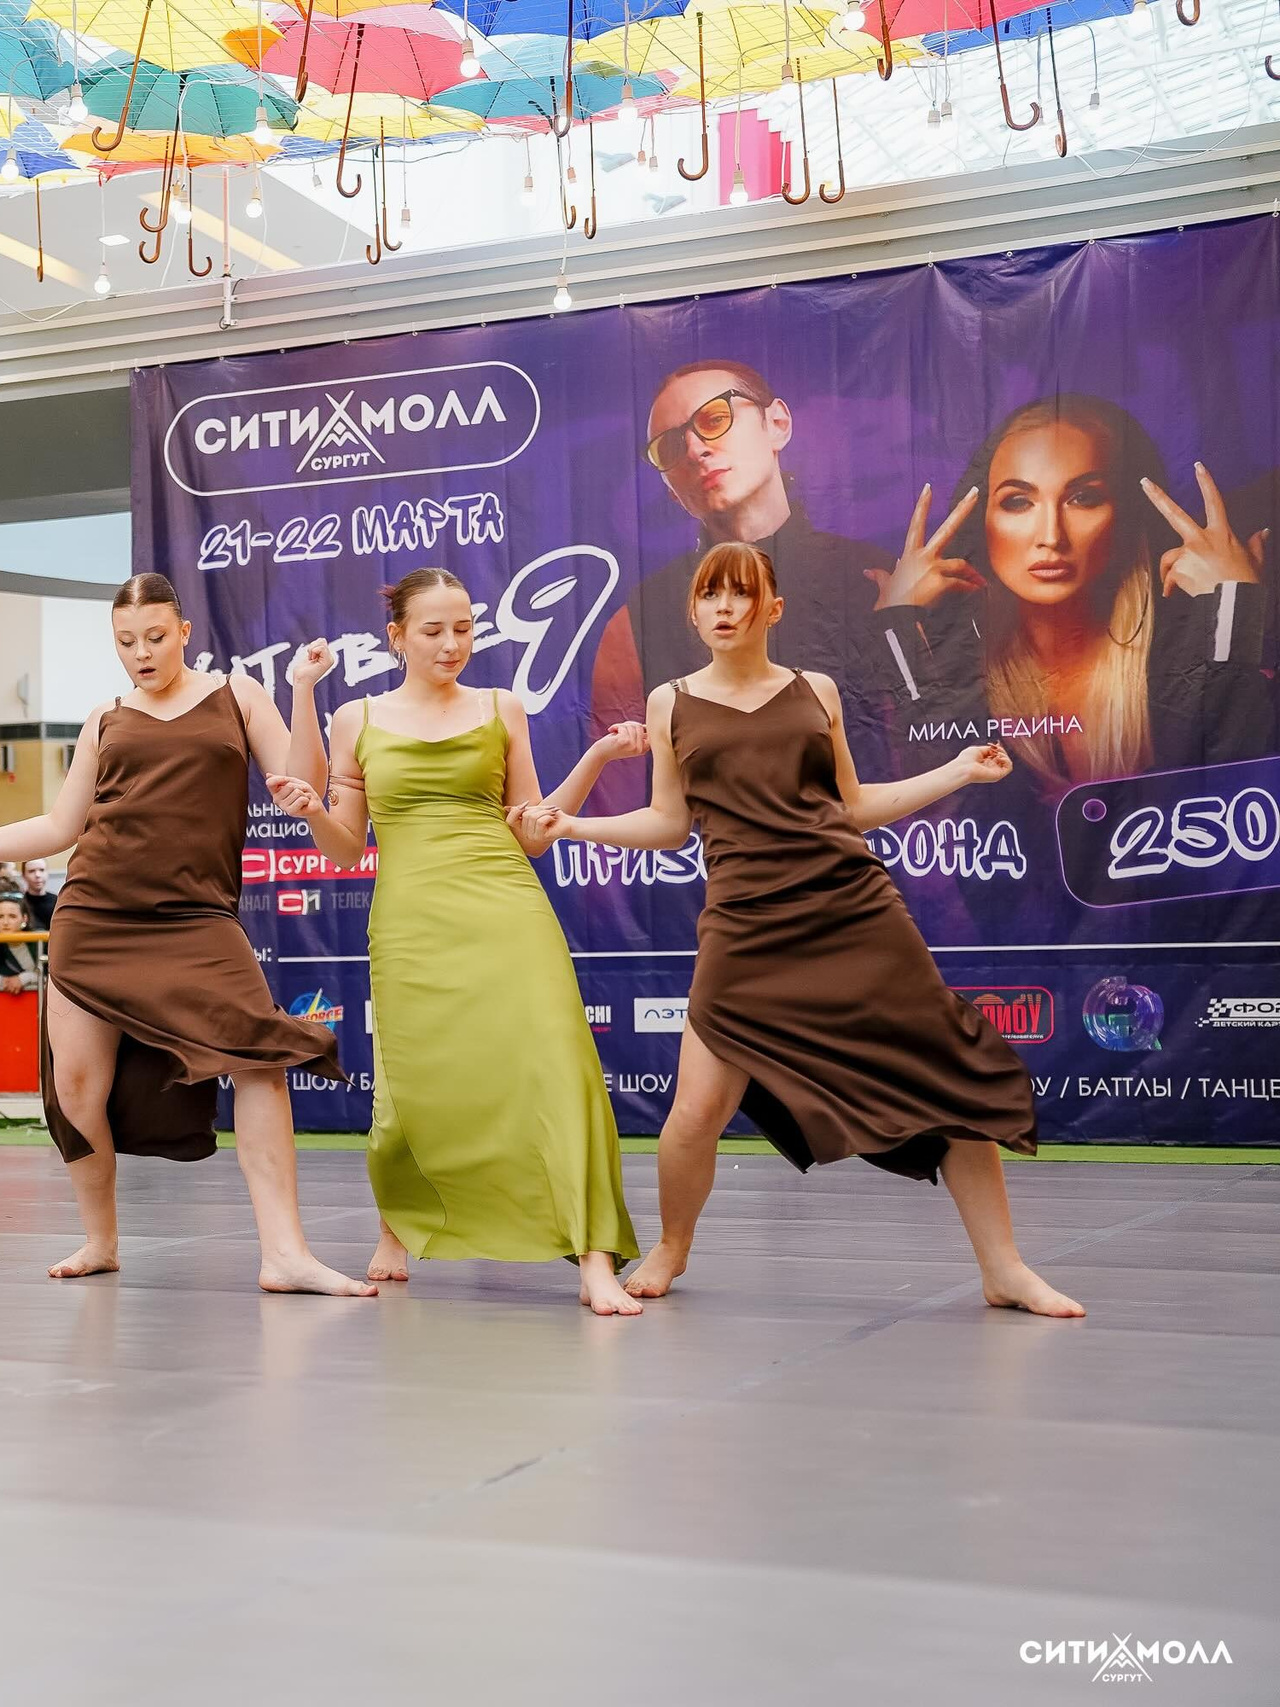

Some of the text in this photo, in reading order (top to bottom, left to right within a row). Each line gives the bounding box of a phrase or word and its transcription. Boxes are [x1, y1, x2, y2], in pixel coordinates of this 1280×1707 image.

[194, 385, 507, 455] СИТИ МОЛЛ
[310, 452, 371, 472] СУРГУТ
[197, 492, 505, 570] 21-22 МАРТА
[909, 715, 1083, 742] МИЛА РЕДИНА
[1107, 787, 1280, 879] 250
[552, 833, 709, 888] ПРИЗ
[331, 891, 370, 909] ТЕЛЕК
[584, 1005, 612, 1023] CHI
[644, 1009, 689, 1019] ЛЭТ
[619, 1074, 673, 1093] ШОУ
[1079, 1077, 1172, 1097] БАТТЛЫ
